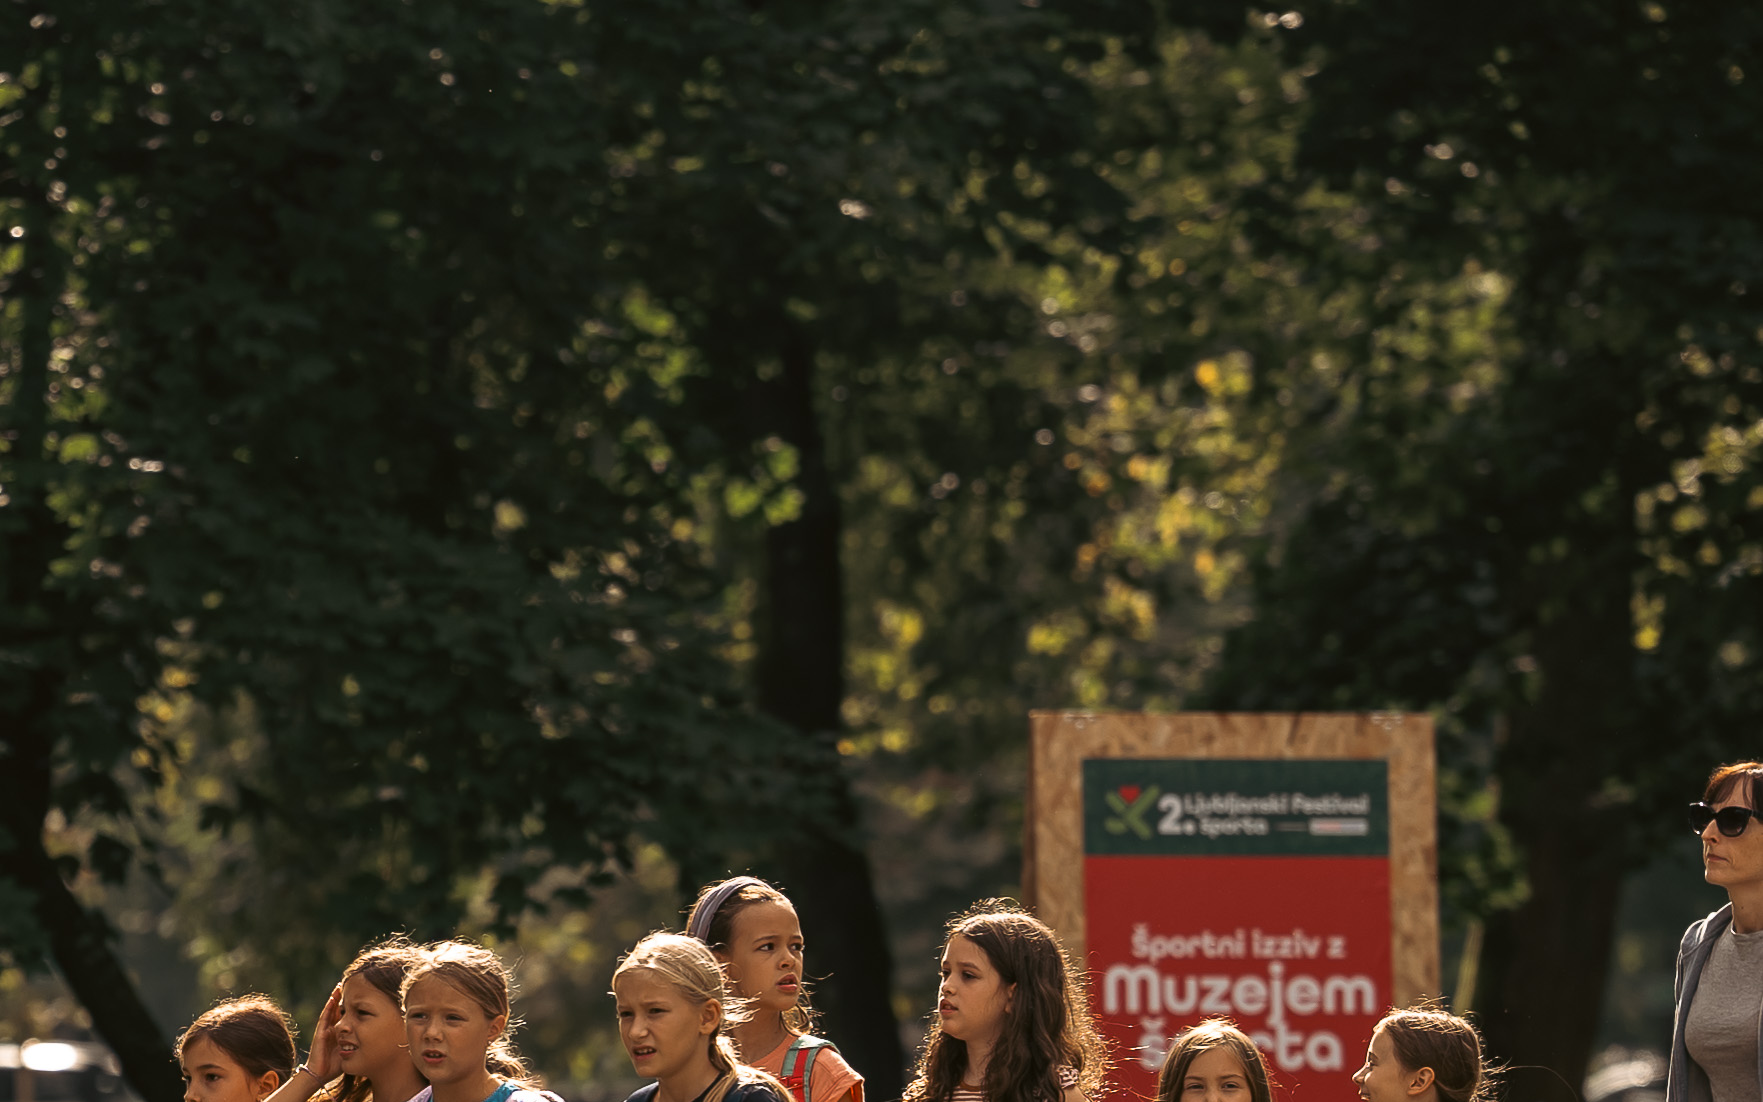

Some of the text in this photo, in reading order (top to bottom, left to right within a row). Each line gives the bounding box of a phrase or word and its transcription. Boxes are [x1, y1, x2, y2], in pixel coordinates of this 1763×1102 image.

[1158, 795, 1195, 835] 2.
[1252, 929, 1320, 958] izziv
[1328, 935, 1345, 958] z
